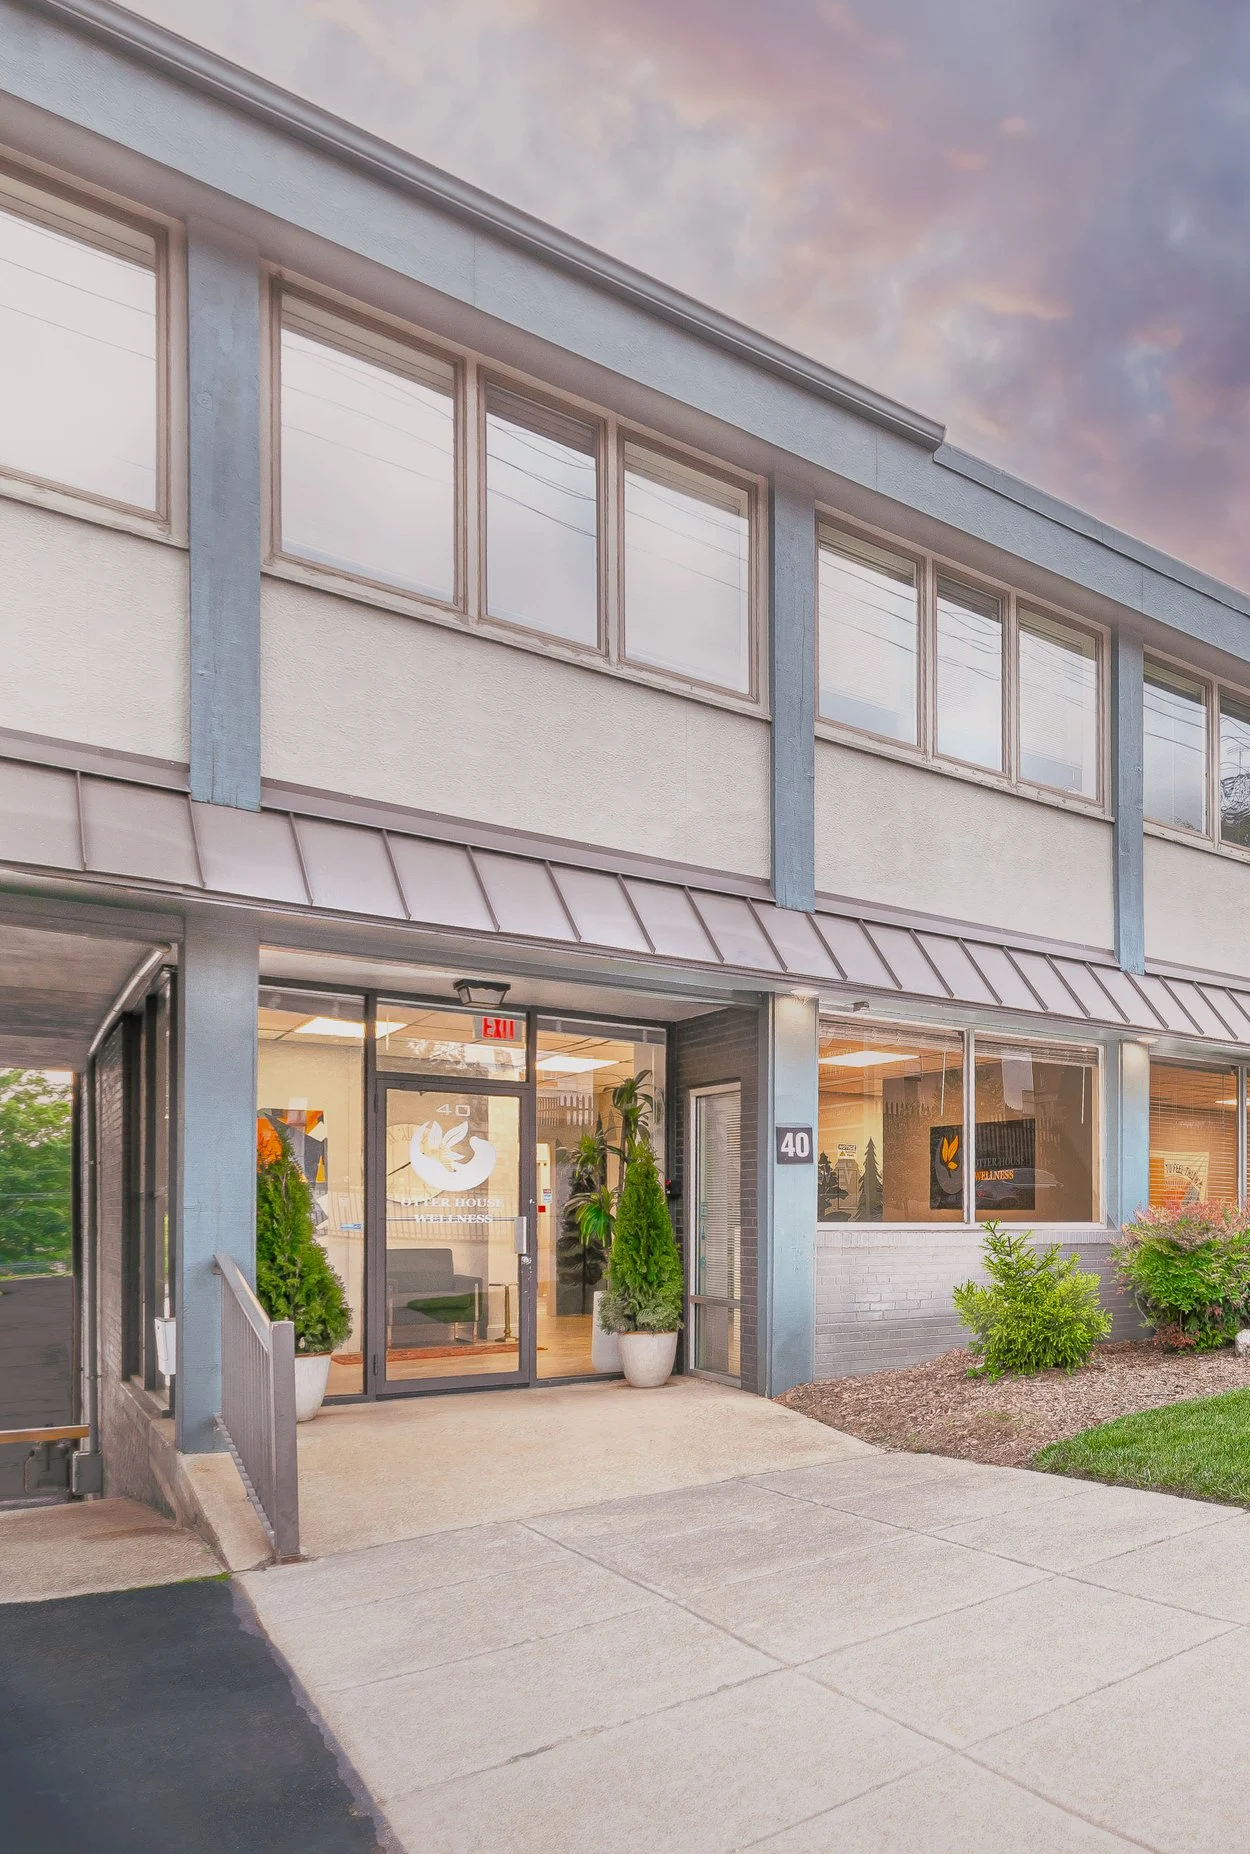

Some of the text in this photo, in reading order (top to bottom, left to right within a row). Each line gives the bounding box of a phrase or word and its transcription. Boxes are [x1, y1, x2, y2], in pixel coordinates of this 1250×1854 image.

[435, 1103, 471, 1117] 40
[780, 1132, 810, 1158] 40
[975, 1169, 1015, 1181] WELLNESS
[454, 1197, 505, 1209] HOUSE
